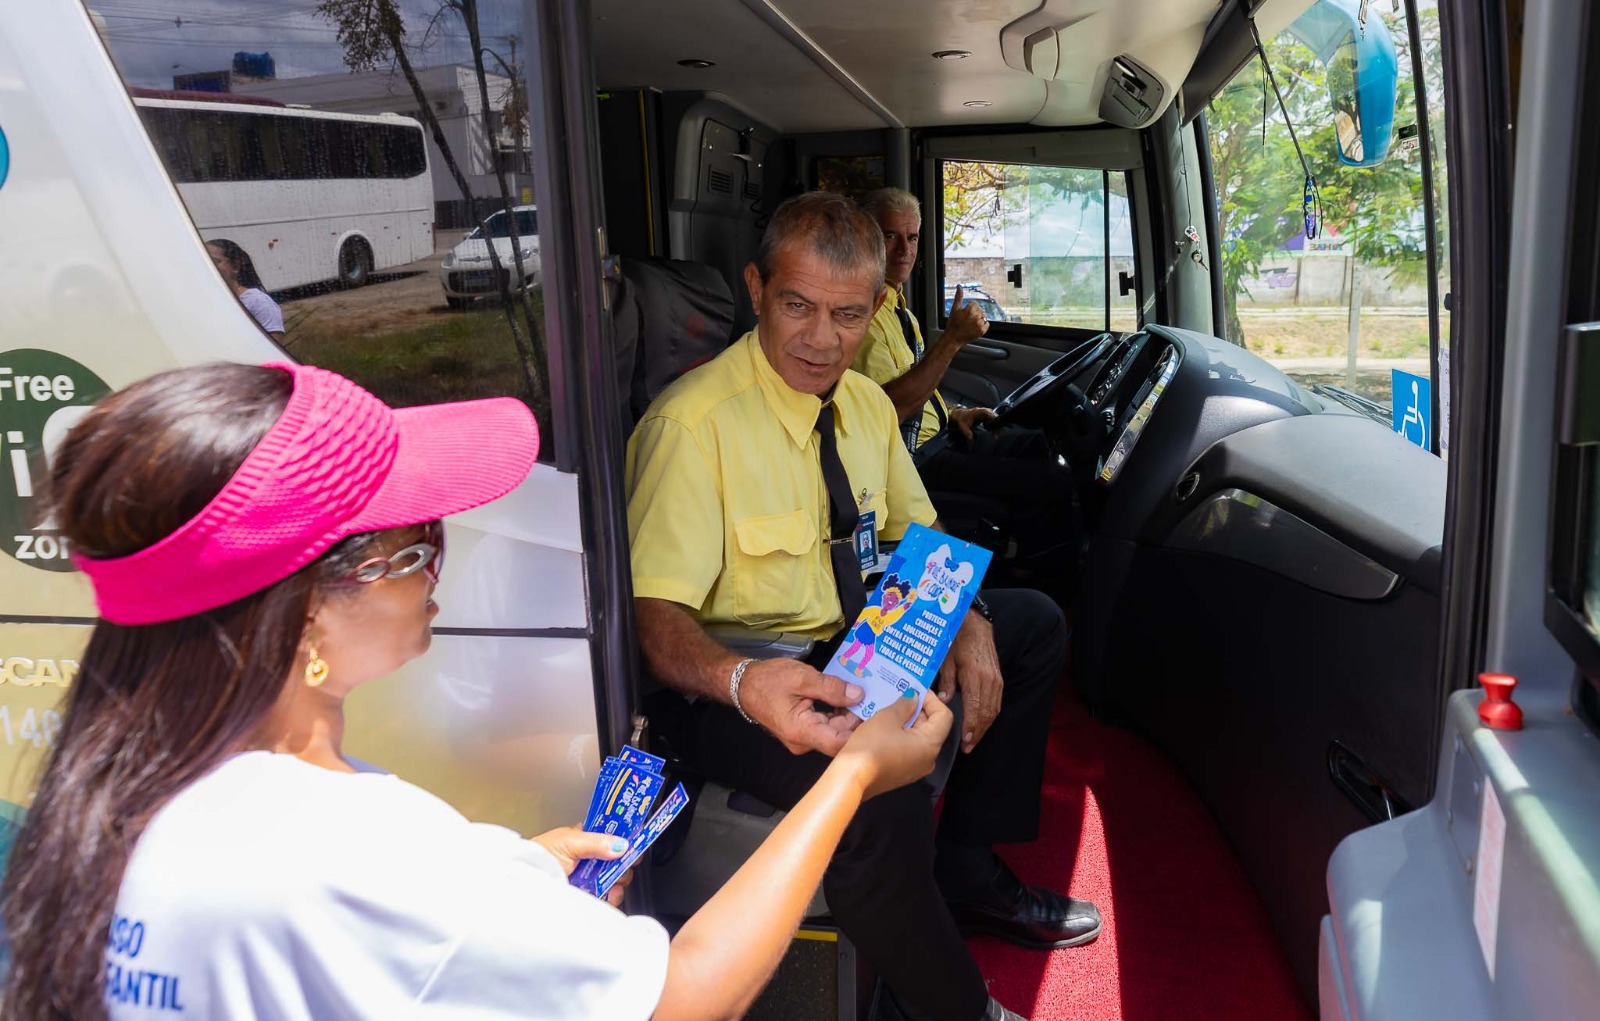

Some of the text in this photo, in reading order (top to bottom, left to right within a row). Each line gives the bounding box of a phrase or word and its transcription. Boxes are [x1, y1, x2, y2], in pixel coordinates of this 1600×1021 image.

[0, 367, 75, 401] Free
[915, 618, 939, 635] CRIANÇAS
[921, 610, 947, 627] PROTEGER
[882, 635, 903, 651] SEXUAL
[905, 647, 922, 662] DEVER
[920, 657, 930, 666] DE
[883, 625, 934, 656] CONTRA EXPLORAÇÃO
[902, 623, 938, 647] ADOLESCENTES
[879, 645, 896, 660] TODAS
[895, 654, 903, 664] AS
[902, 659, 925, 676] PESSOAS
